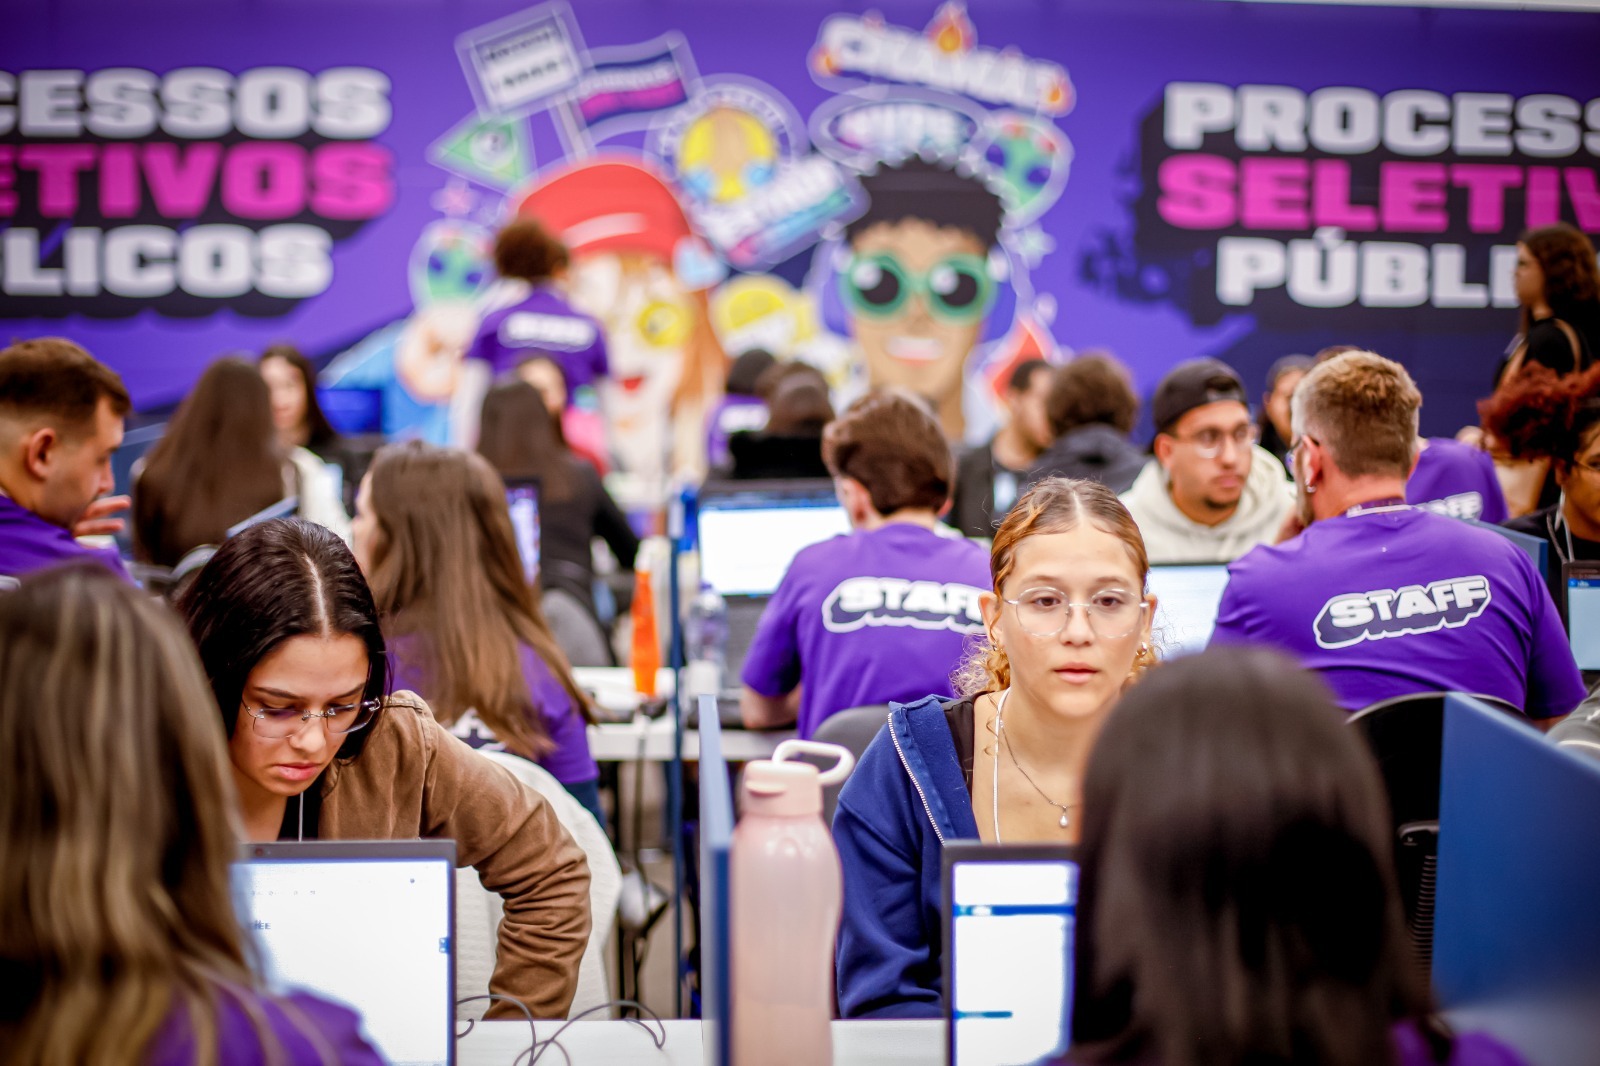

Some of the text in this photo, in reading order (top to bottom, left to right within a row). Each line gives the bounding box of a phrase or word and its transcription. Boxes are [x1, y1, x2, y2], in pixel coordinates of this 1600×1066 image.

[0, 66, 393, 139] ESSOS
[1163, 81, 1600, 157] PROCES
[0, 141, 395, 220] TIVOS
[1216, 225, 1520, 308] PÚBLI
[1327, 578, 1489, 630] STAFF
